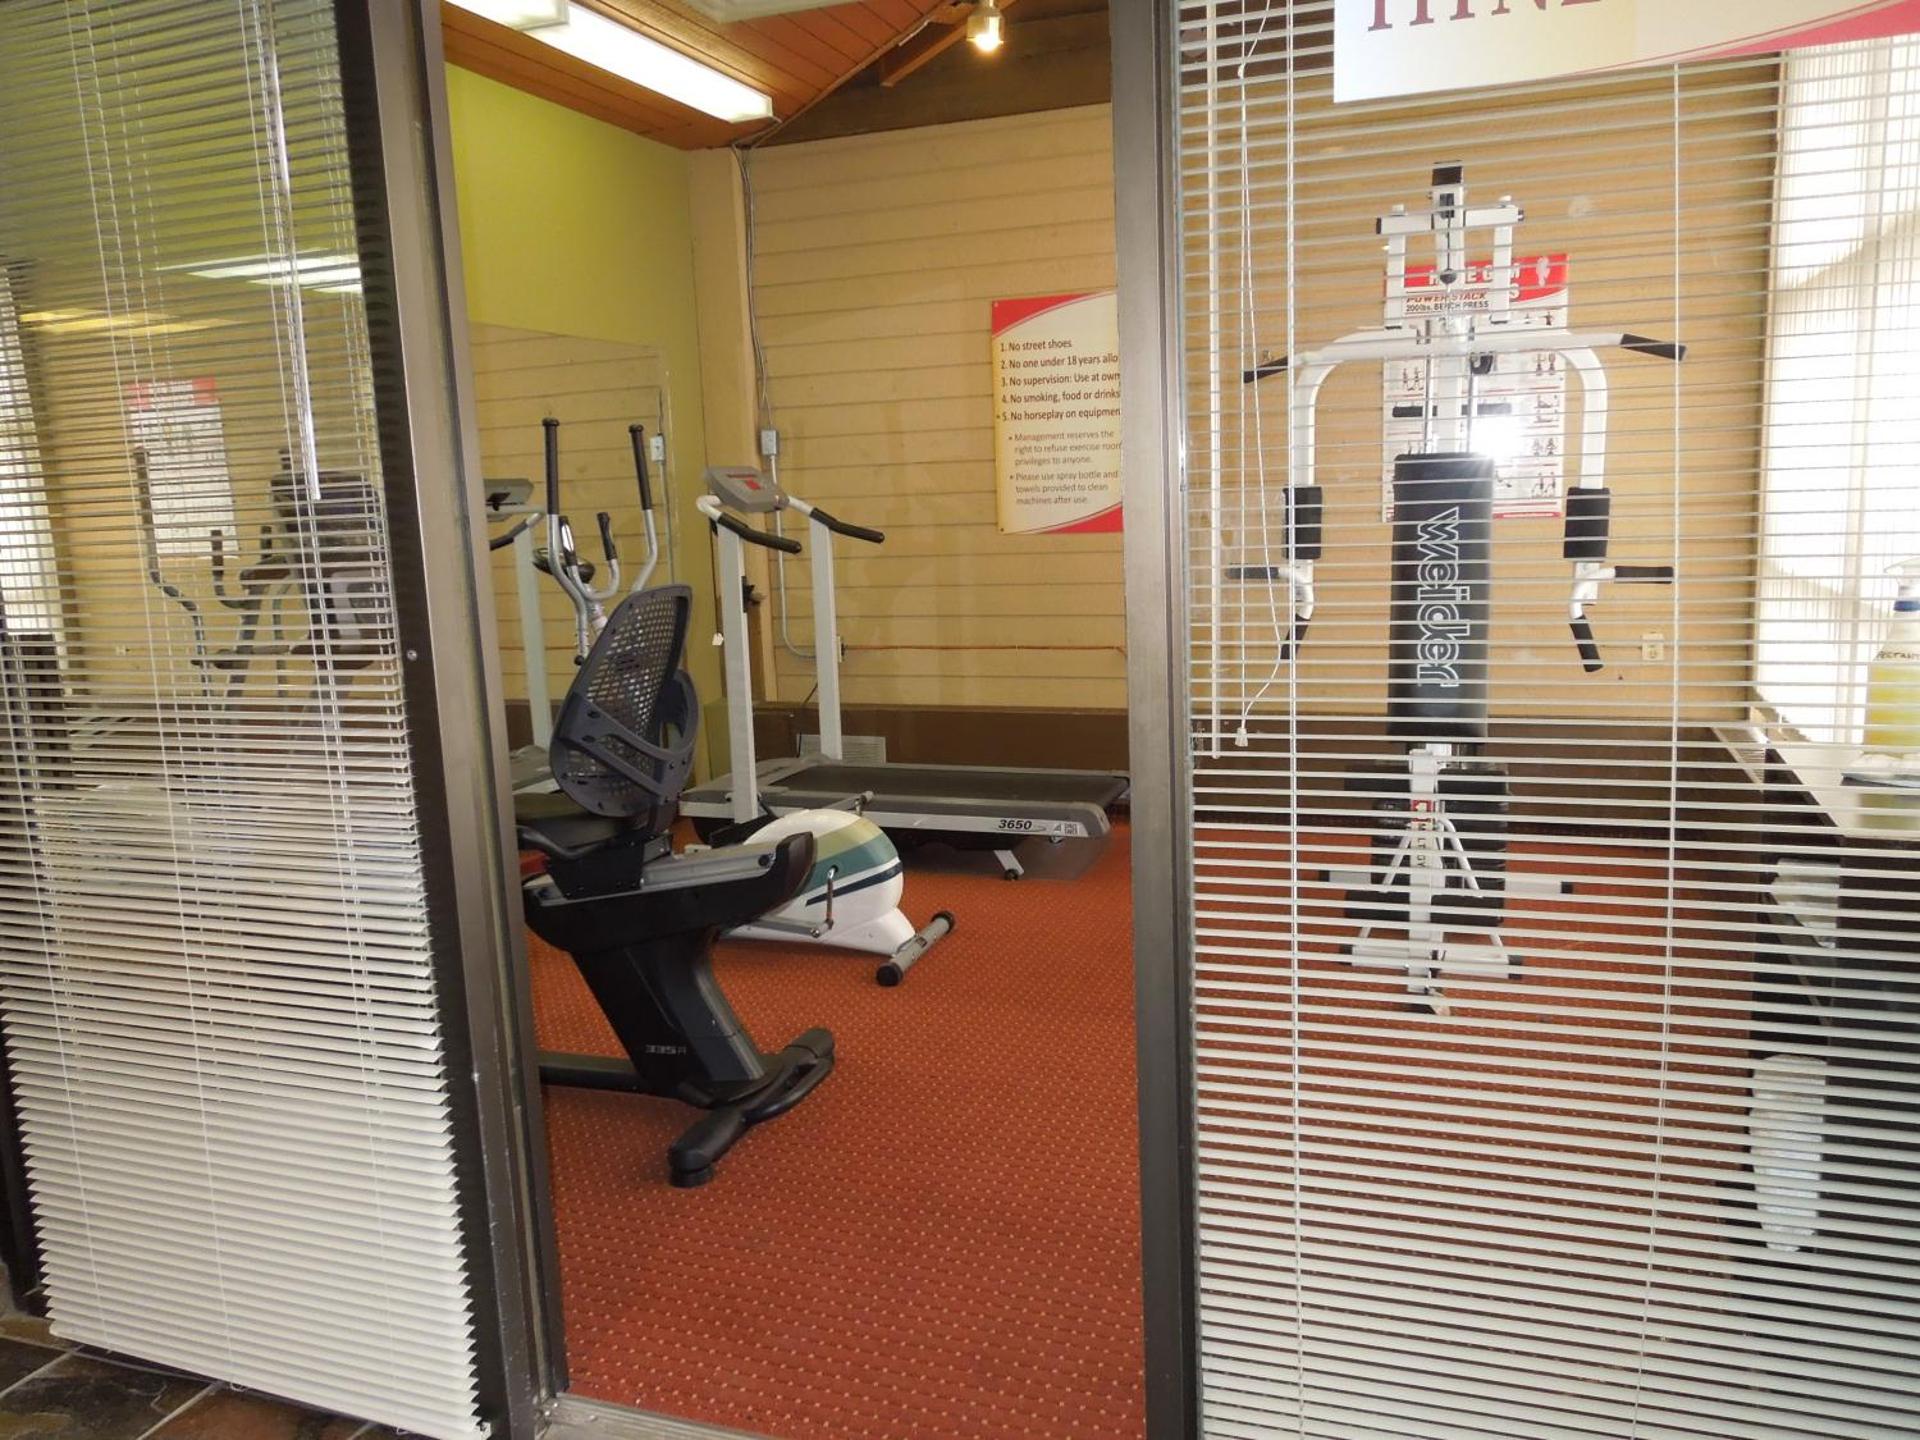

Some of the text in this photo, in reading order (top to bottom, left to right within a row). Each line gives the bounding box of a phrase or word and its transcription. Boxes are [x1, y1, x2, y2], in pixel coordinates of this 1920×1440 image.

[1451, 291, 1487, 301] STACK
[1463, 300, 1489, 309] PRESS
[1001, 339, 1072, 352] 1. No street shoes
[1001, 353, 1119, 369] 2. No one under 18 years allo
[1001, 372, 1120, 387] 3. No supervision: Use at own
[1002, 394, 1008, 403] 4.
[1010, 394, 1021, 403] No
[1023, 392, 1060, 403] smoking,
[1062, 390, 1081, 400] food
[1094, 389, 1120, 399] drinks
[1003, 407, 1120, 421] 5. No horseplay on equipmen
[1014, 430, 1114, 443] Management reserves the
[1014, 445, 1032, 455] right
[1034, 445, 1042, 453] to
[1044, 444, 1067, 453] refuse
[1069, 443, 1100, 451] exercise
[1014, 456, 1050, 467] privileges
[1052, 456, 1060, 464] to
[1016, 470, 1118, 481] Please use spray bottle and
[1015, 482, 1109, 493] towels provided to clean
[1016, 495, 1051, 504] machines
[1053, 495, 1071, 503] after
[998, 819, 1033, 830] 3650
